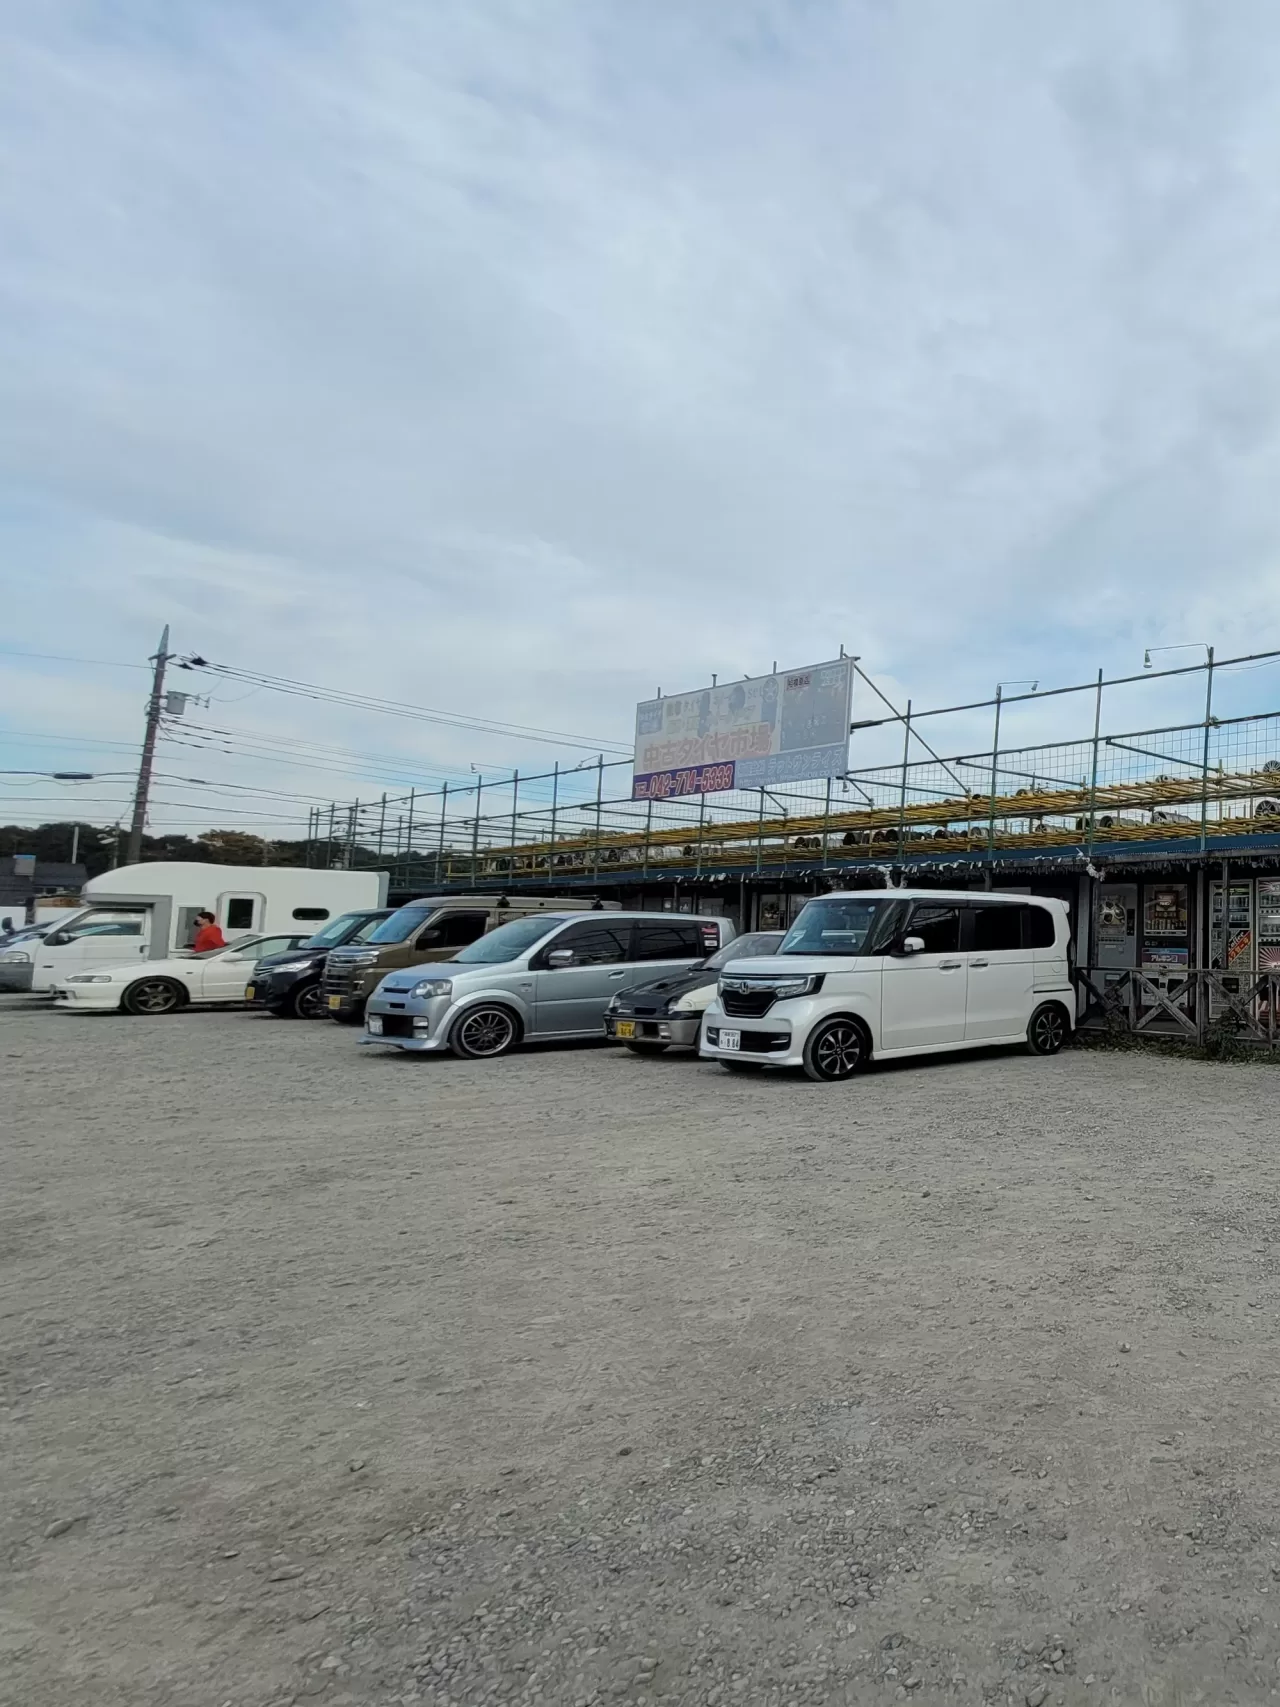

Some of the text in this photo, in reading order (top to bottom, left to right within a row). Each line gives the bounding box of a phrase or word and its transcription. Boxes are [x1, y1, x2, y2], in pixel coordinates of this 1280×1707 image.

[643, 725, 771, 770] 中古タイヤ市場
[650, 764, 733, 798] 042-714-5333
